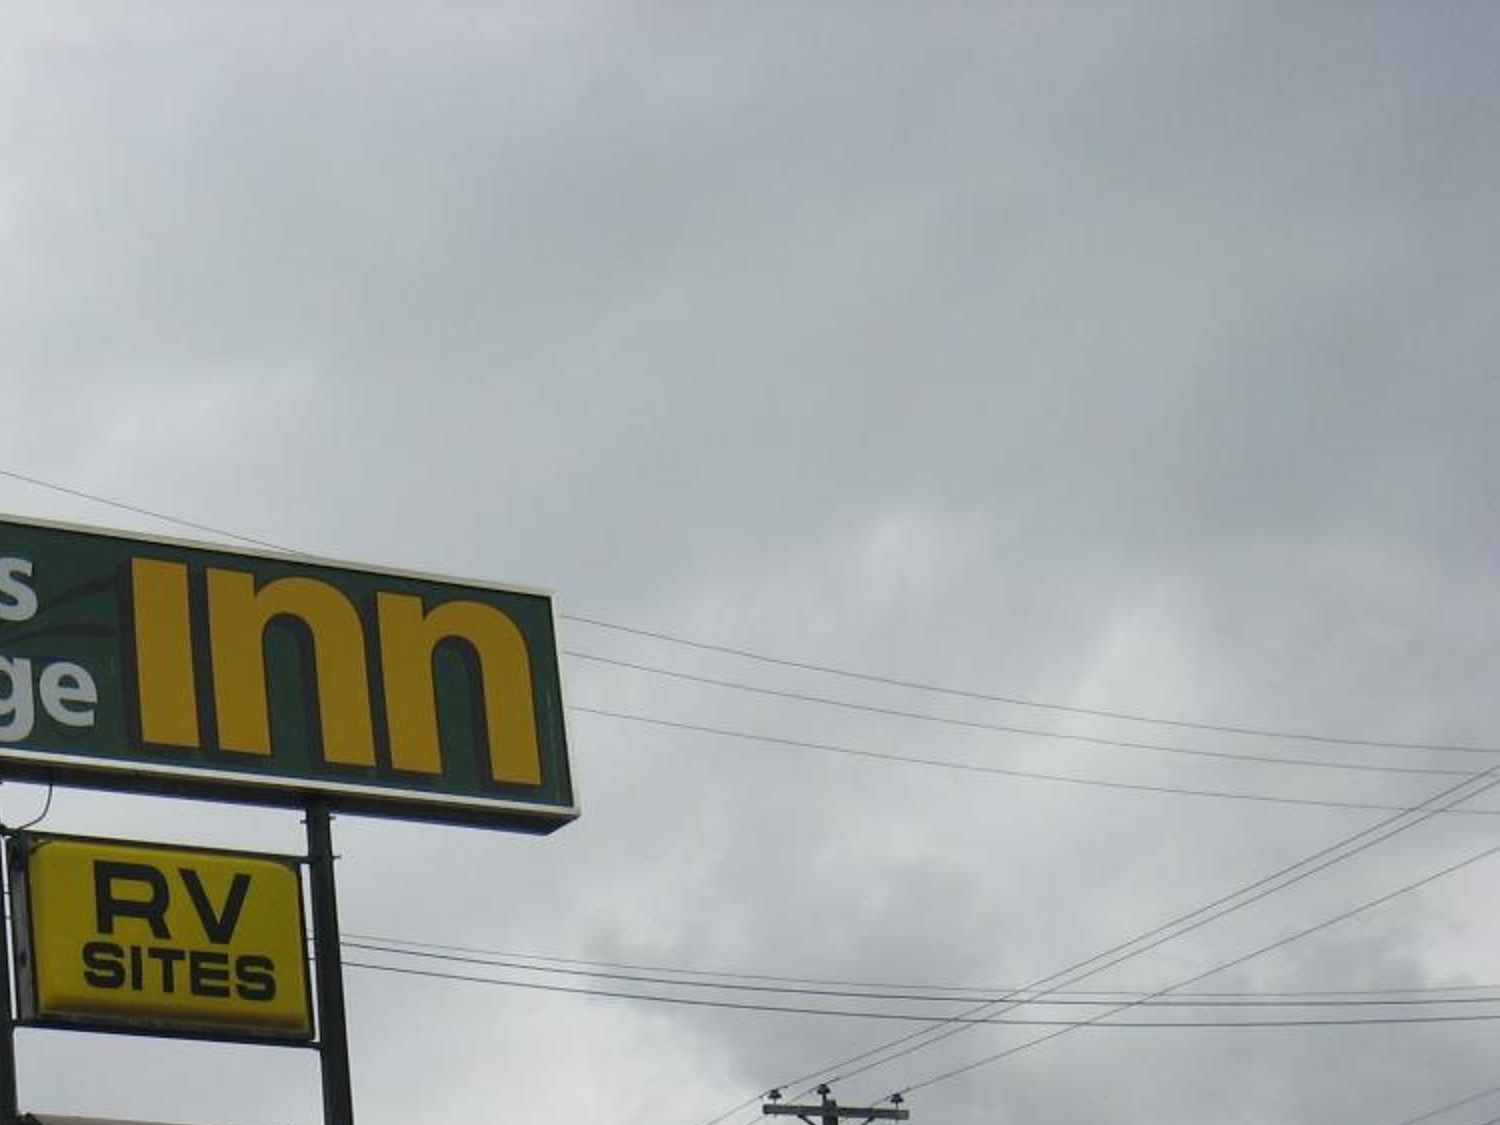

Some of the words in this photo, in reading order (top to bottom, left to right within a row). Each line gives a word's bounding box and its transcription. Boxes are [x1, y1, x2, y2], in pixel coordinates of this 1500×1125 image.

[130, 556, 542, 786] Inn
[93, 859, 251, 945] RV
[83, 942, 277, 1003] SITES
